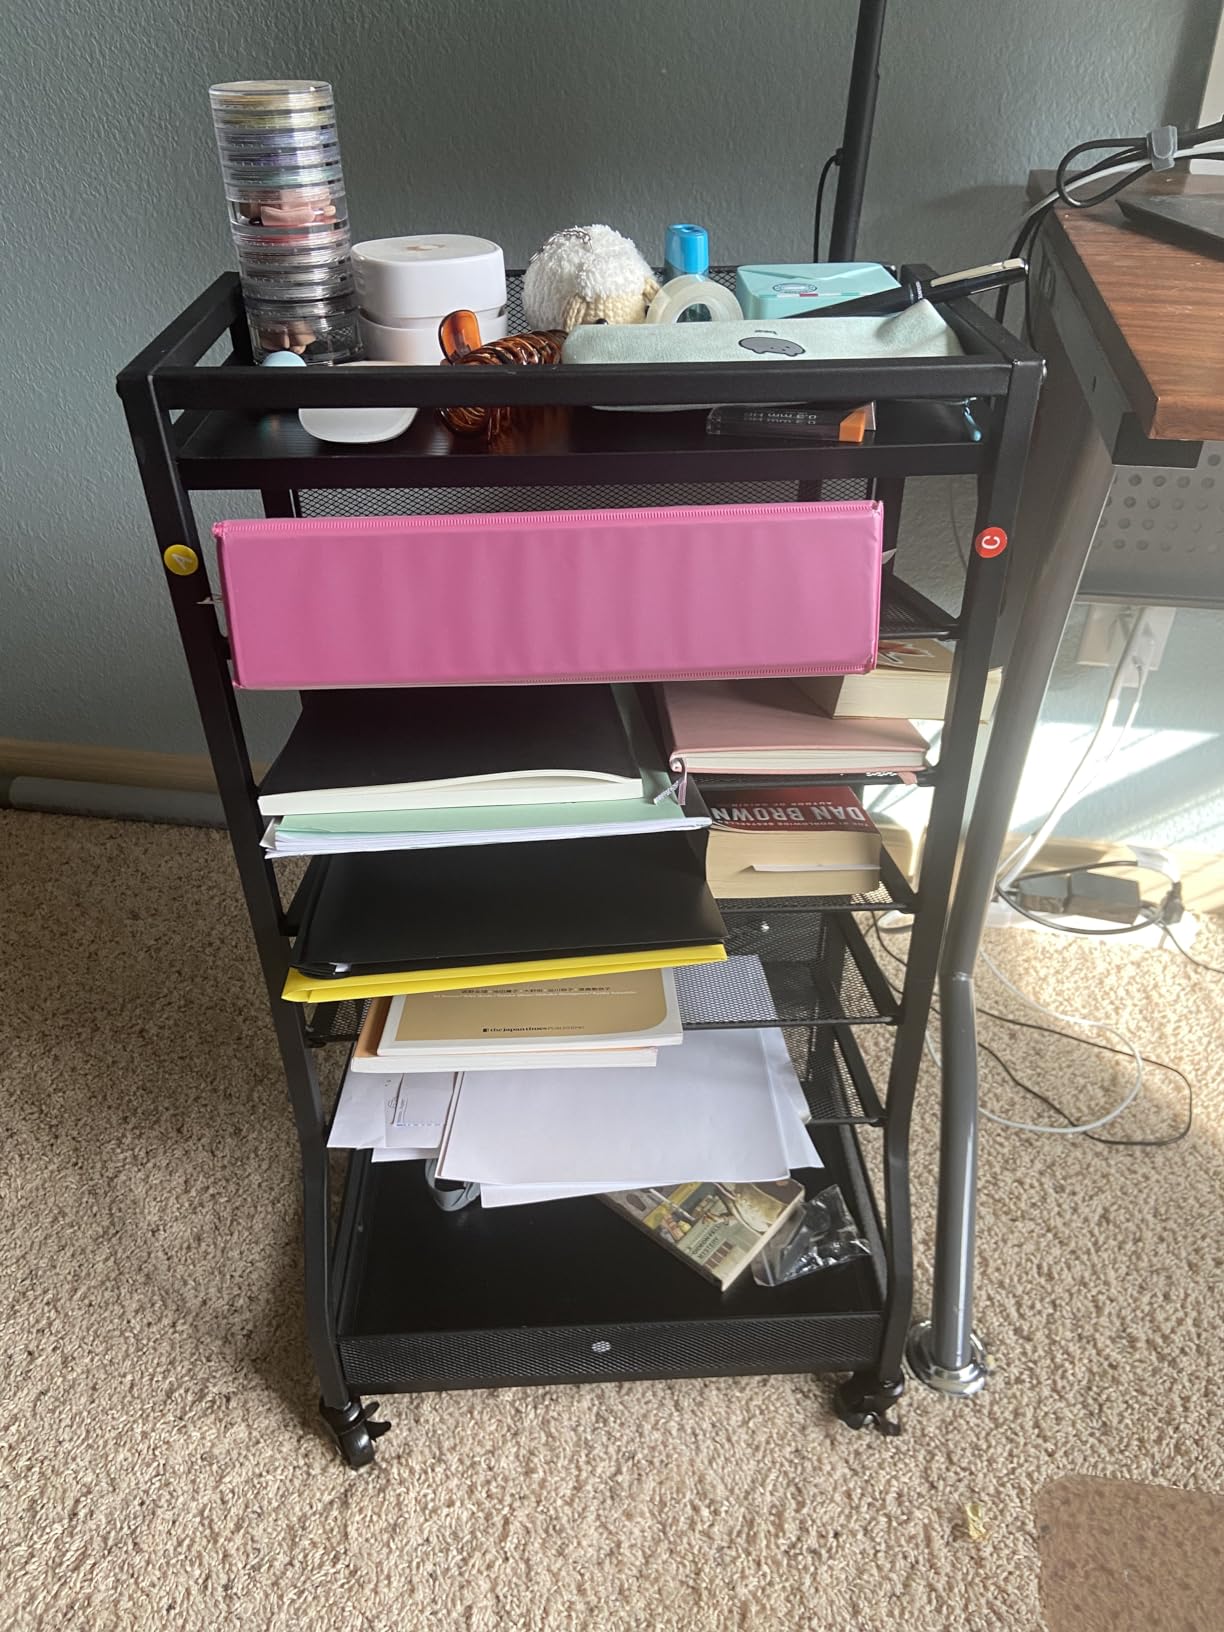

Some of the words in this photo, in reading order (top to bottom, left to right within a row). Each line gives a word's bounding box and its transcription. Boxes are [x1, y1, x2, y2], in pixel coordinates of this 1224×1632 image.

[981, 535, 1000, 549] C
[710, 806, 805, 821] BROWN
[810, 805, 866, 821] DAN
